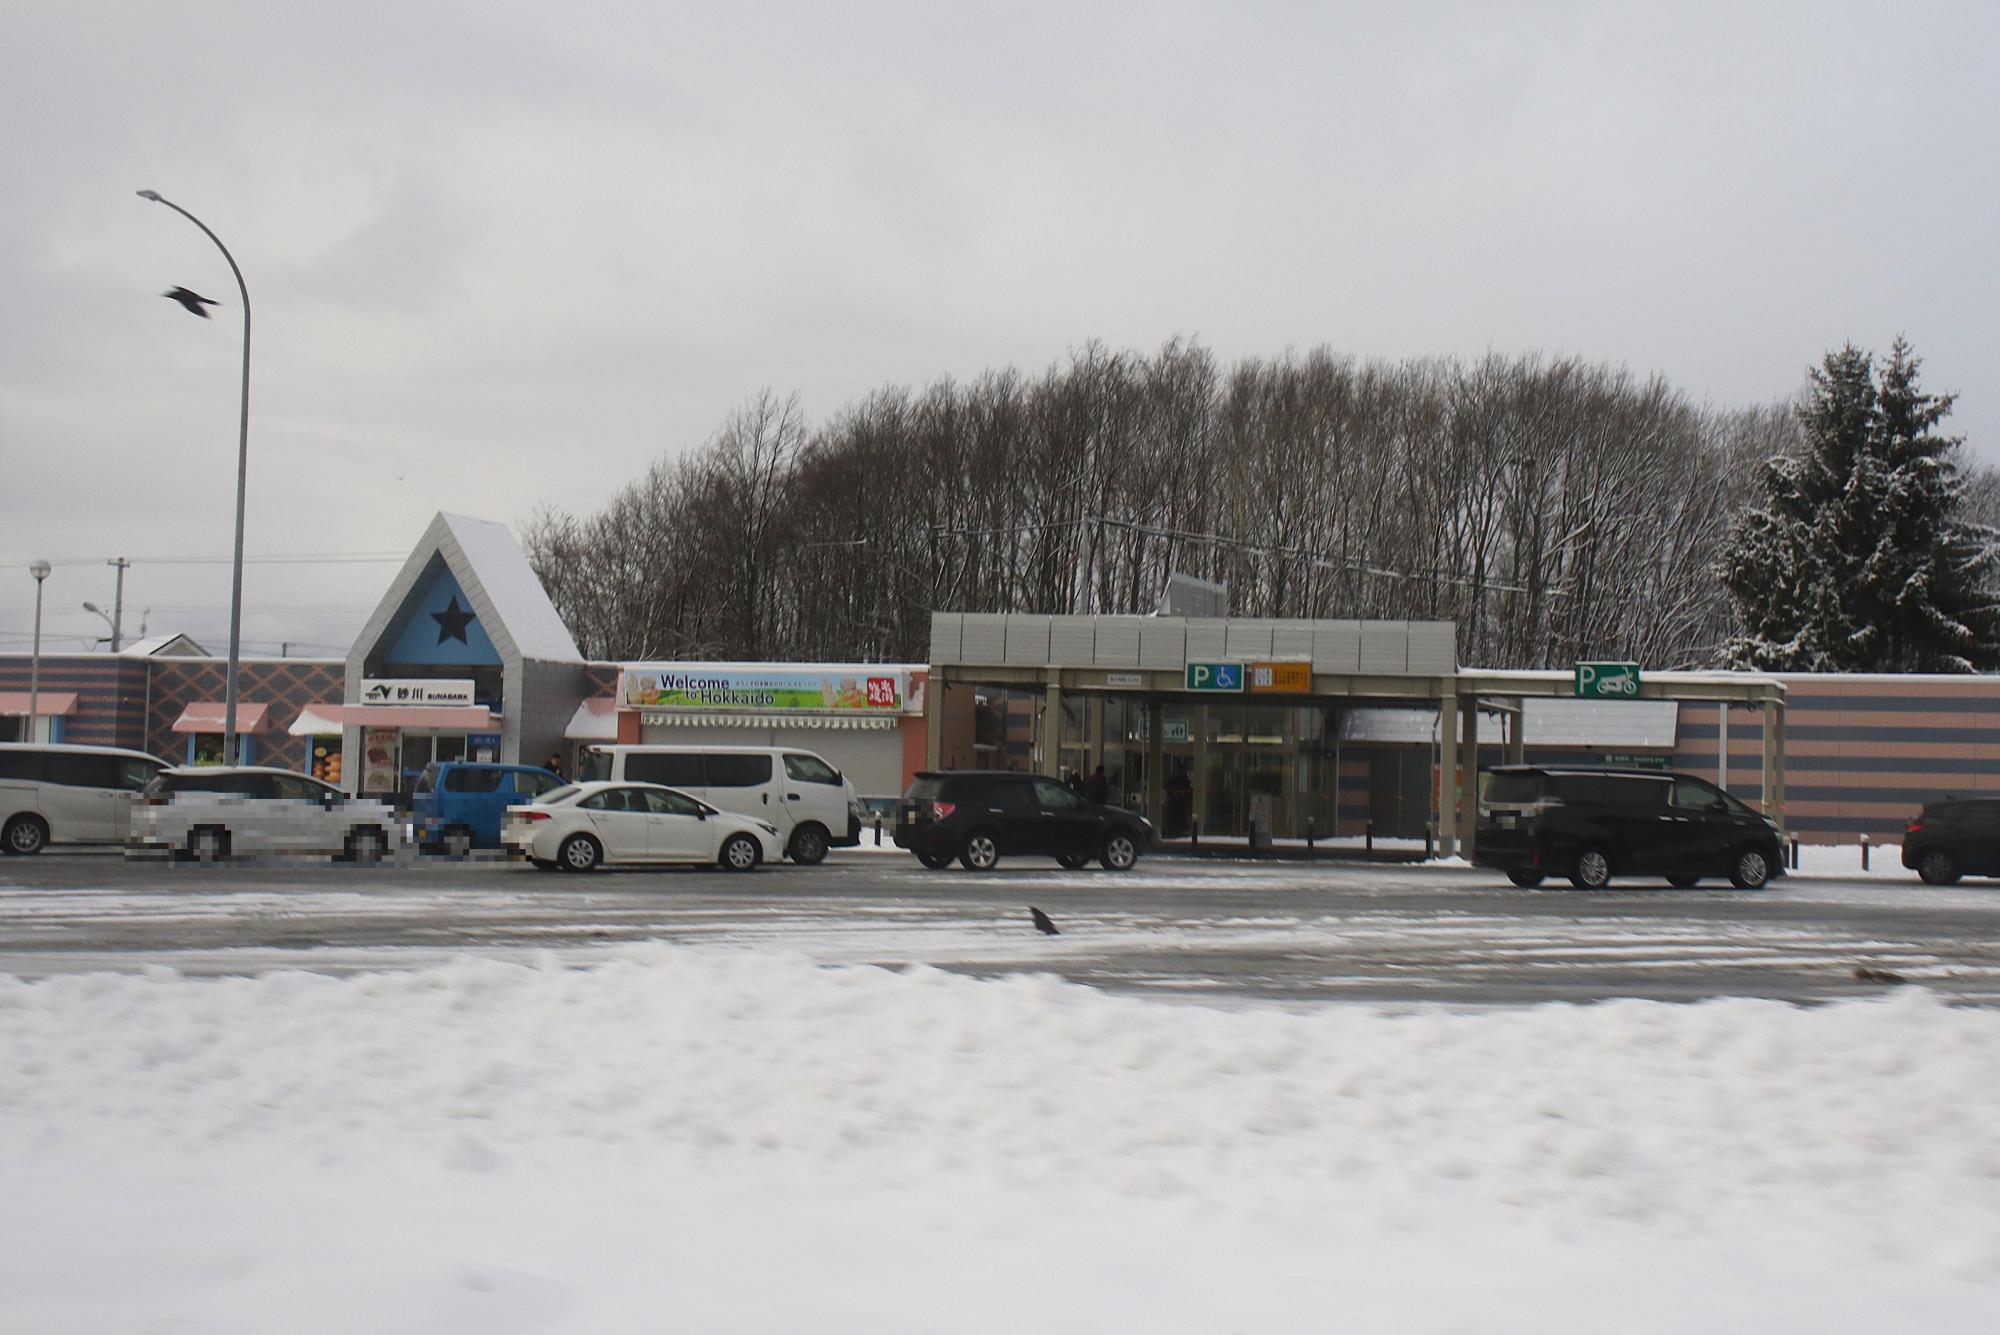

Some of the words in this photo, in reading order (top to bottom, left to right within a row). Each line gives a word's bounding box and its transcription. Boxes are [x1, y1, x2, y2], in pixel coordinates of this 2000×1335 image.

[660, 674, 730, 690] Welcome
[1194, 666, 1210, 687] P
[1580, 665, 1596, 693] P
[685, 689, 697, 699] to
[701, 689, 775, 704] Hokkaido
